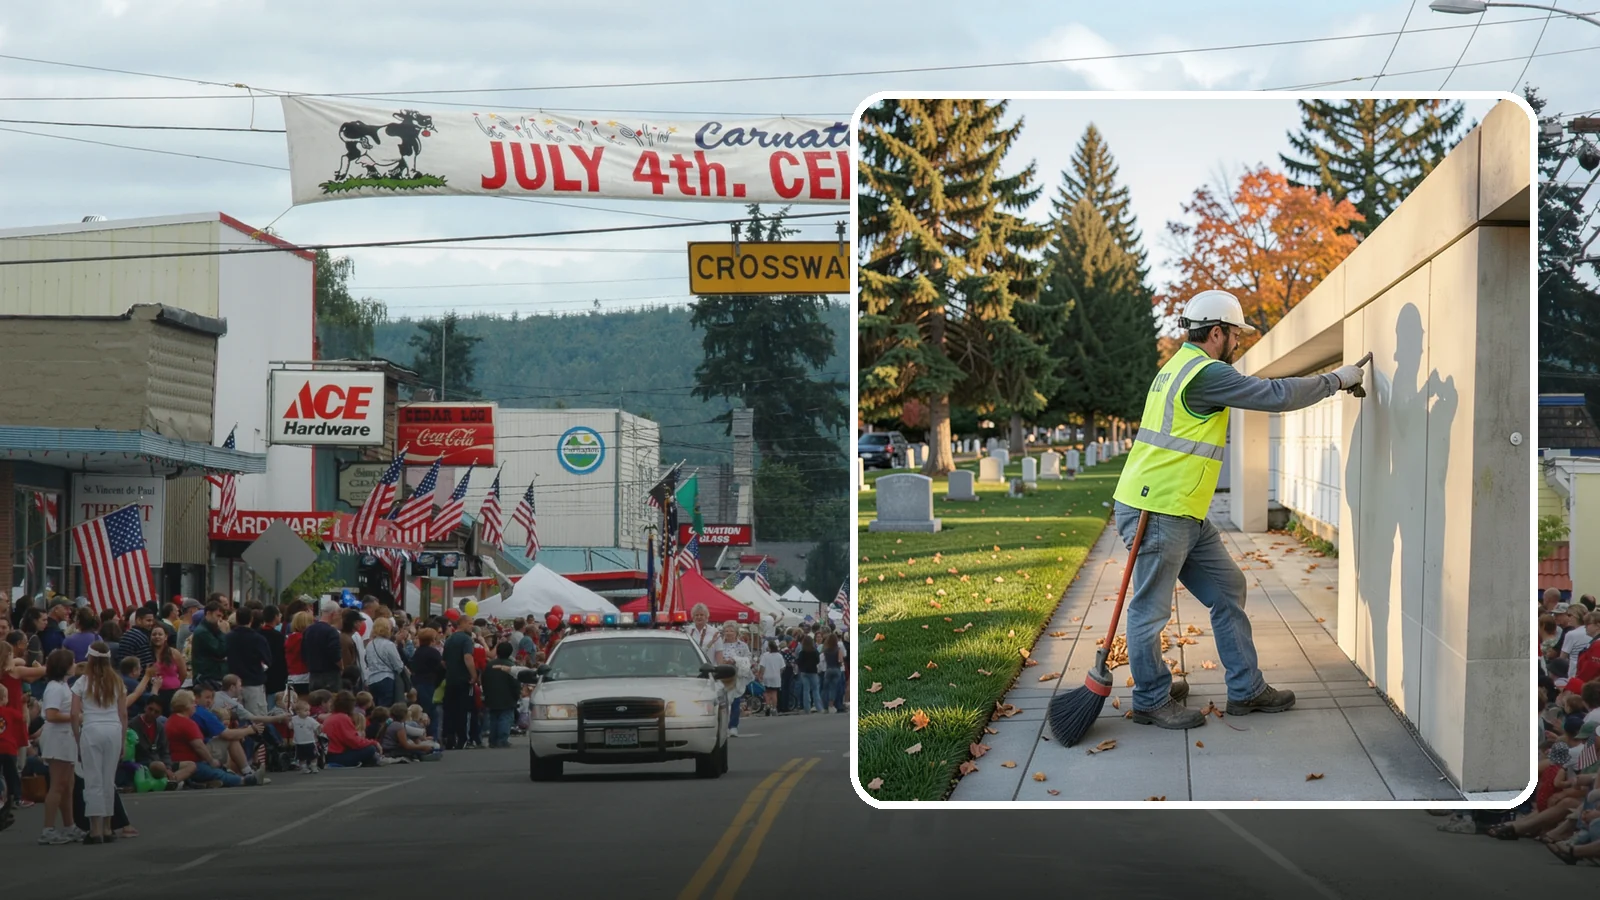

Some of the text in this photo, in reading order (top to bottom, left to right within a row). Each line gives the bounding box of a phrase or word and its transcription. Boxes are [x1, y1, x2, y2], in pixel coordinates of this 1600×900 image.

[695, 121, 850, 150] Carnat
[481, 141, 605, 192] JULY
[632, 150, 746, 198] 4th.
[697, 254, 850, 280] CROSSWA
[283, 380, 373, 420] ACE
[406, 409, 485, 422] CEDAR LOG
[283, 421, 371, 437] Hardware
[416, 428, 477, 447] Coca-Cola
[354, 467, 385, 480] Simpl
[83, 484, 155, 495] St. Vincent de Paul
[81, 503, 153, 521] THT
[212, 516, 331, 536] HARDARE
[688, 526, 741, 535] CRNATION
[699, 535, 730, 543] GLASS
